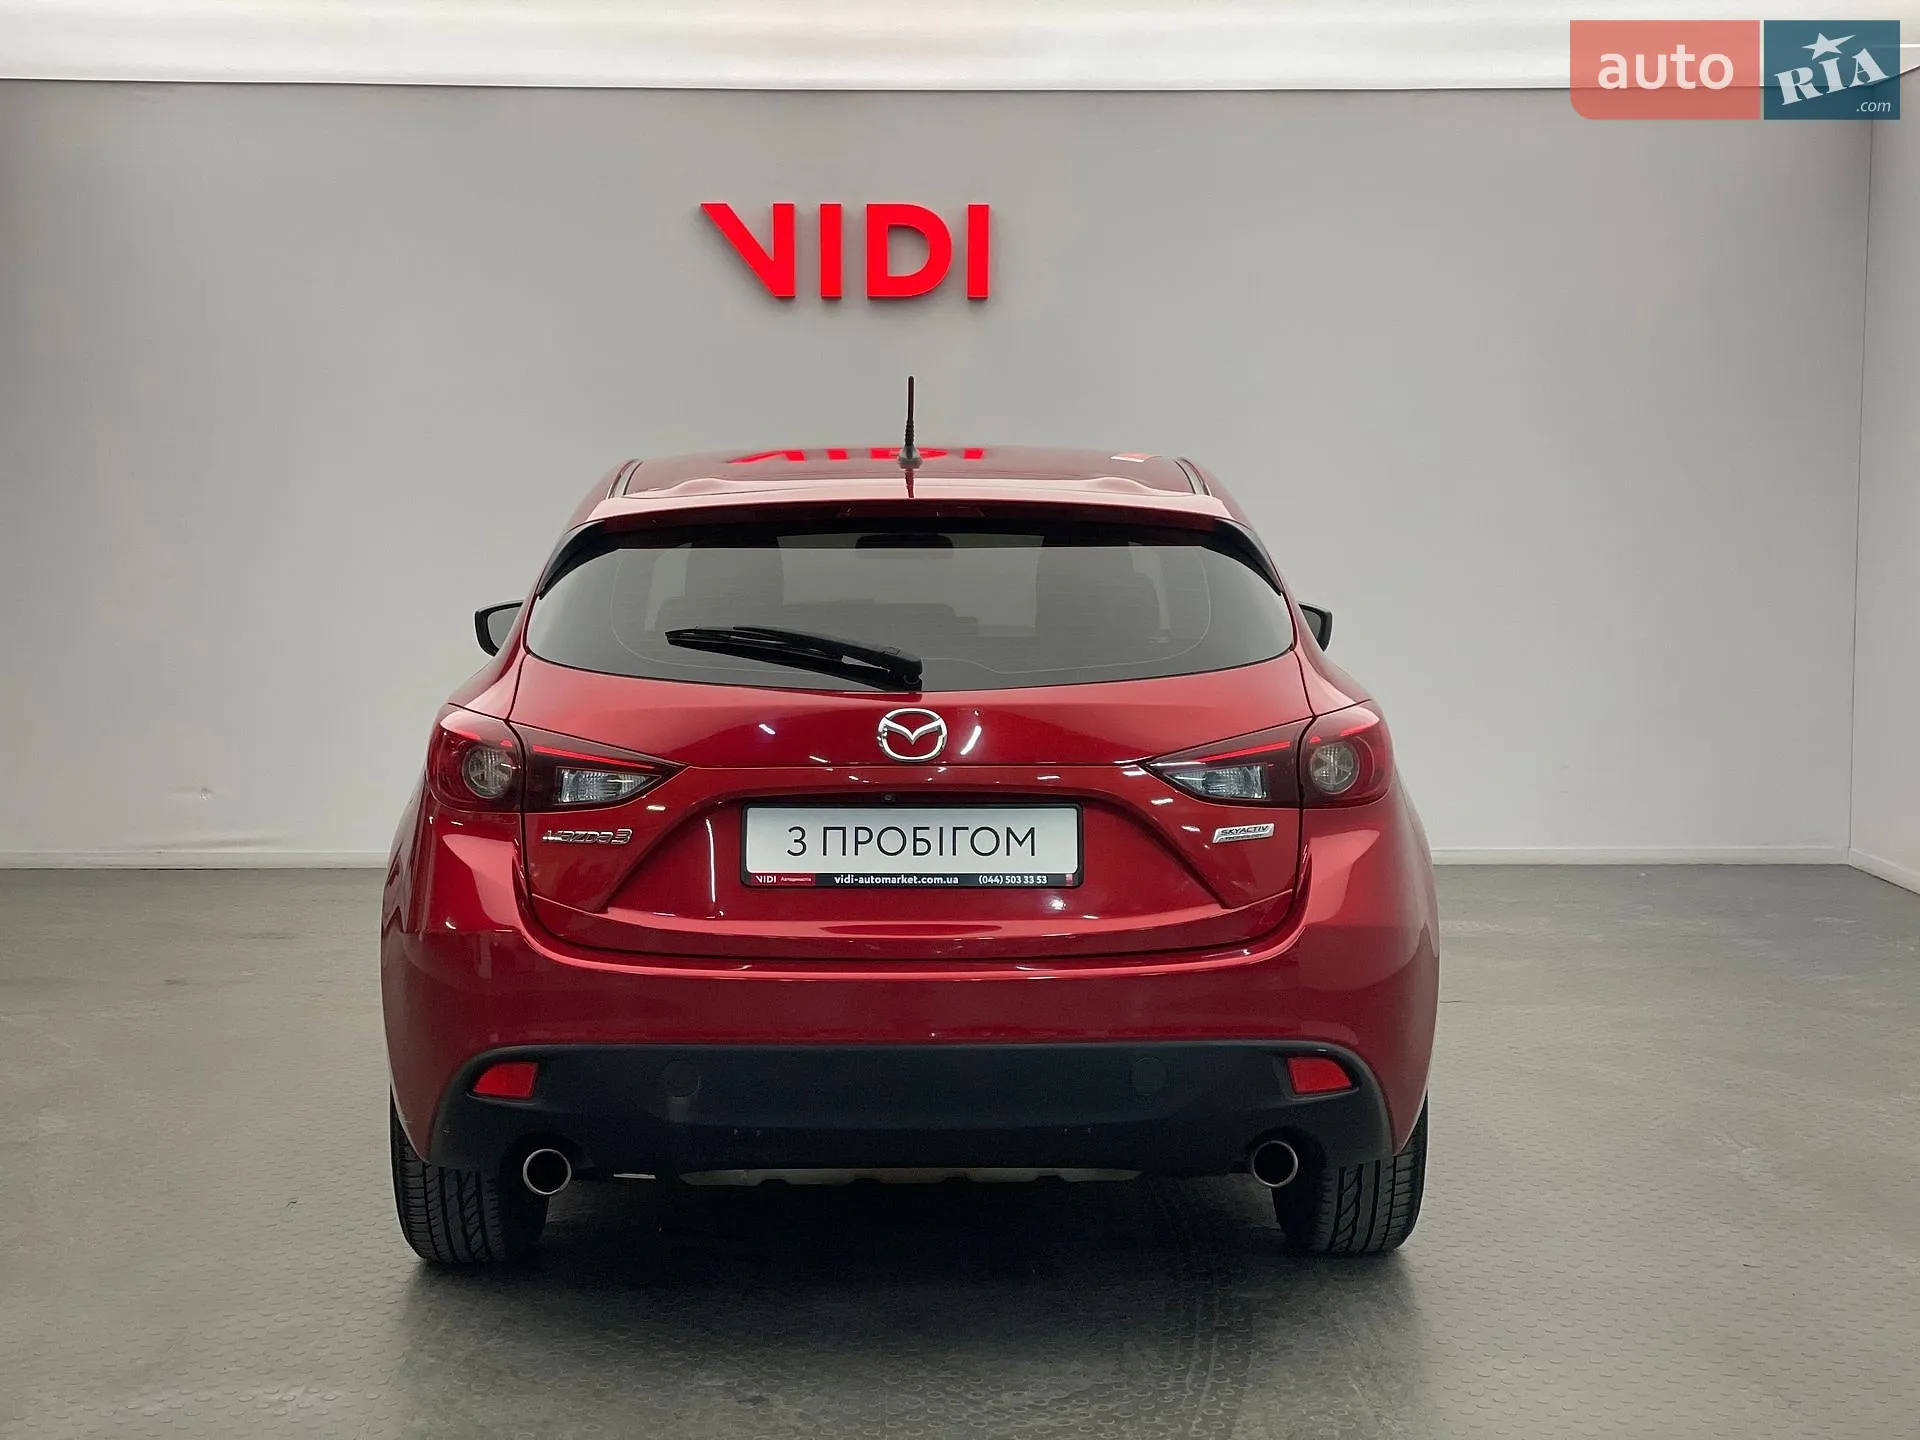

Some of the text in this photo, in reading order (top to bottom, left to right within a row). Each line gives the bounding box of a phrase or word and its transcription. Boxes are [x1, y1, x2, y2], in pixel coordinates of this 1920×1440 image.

[700, 203, 990, 300] VIDI
[1220, 825, 1269, 836] SKYACTIV
[822, 826, 1036, 857] ПРОБІГОМ
[755, 875, 777, 884] VIDI
[834, 874, 959, 885] vidi-automarket.com.ua
[979, 875, 1048, 885] (044) 503 33 53
